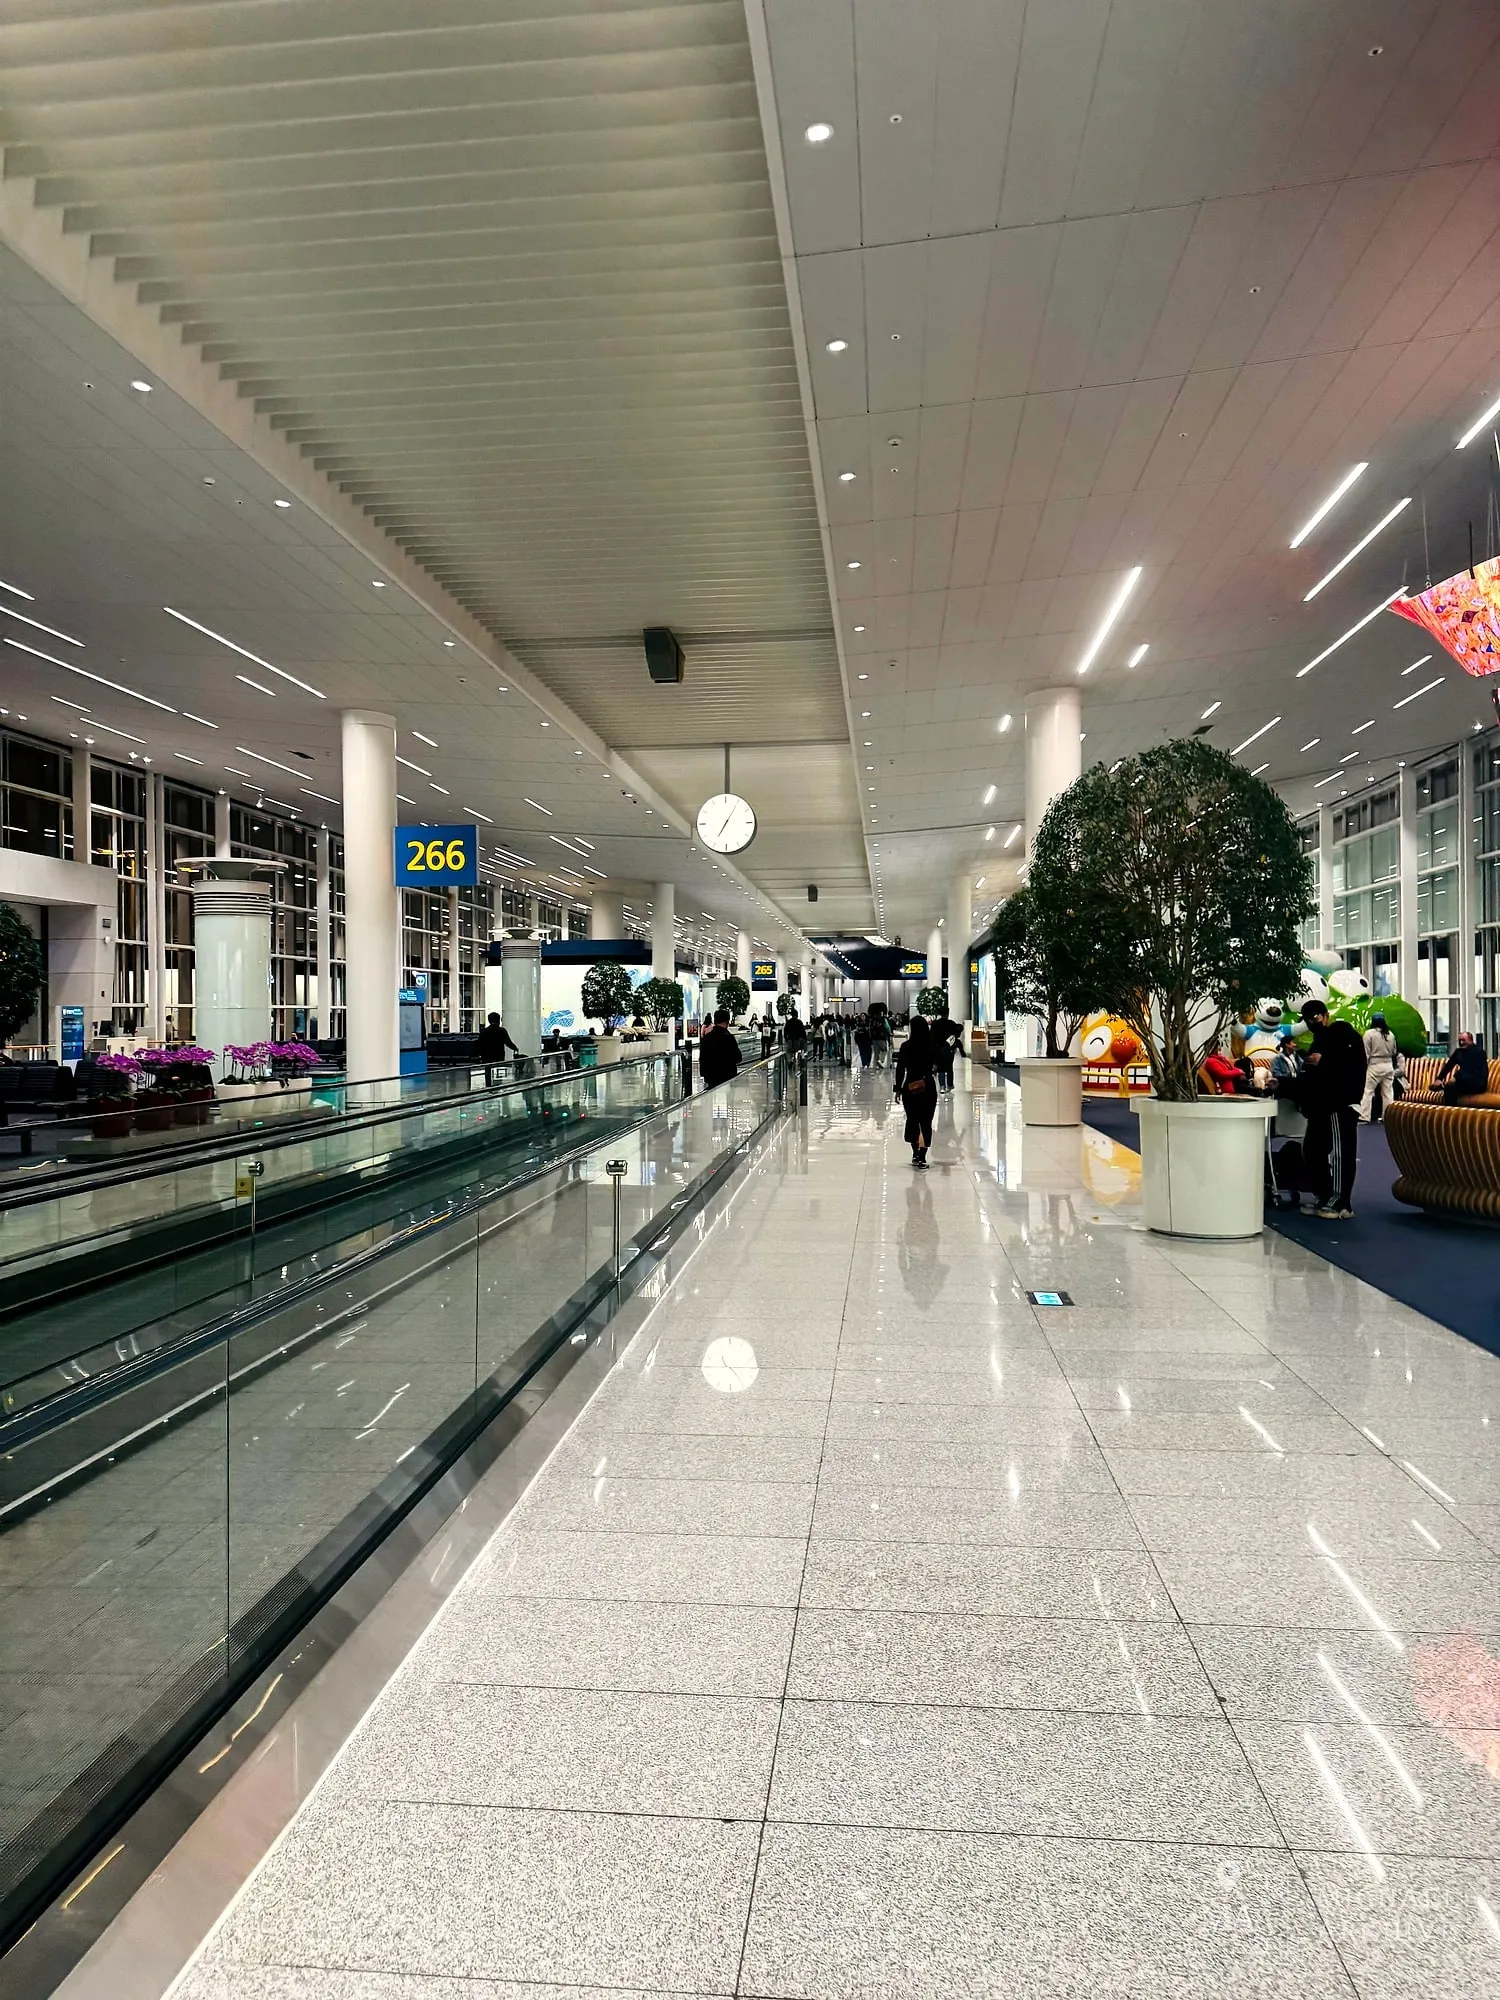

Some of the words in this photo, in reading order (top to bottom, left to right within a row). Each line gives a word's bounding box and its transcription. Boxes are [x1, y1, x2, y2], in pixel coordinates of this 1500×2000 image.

[407, 840, 465, 871] 266
[754, 965, 773, 975] 265
[905, 963, 924, 974] 255
